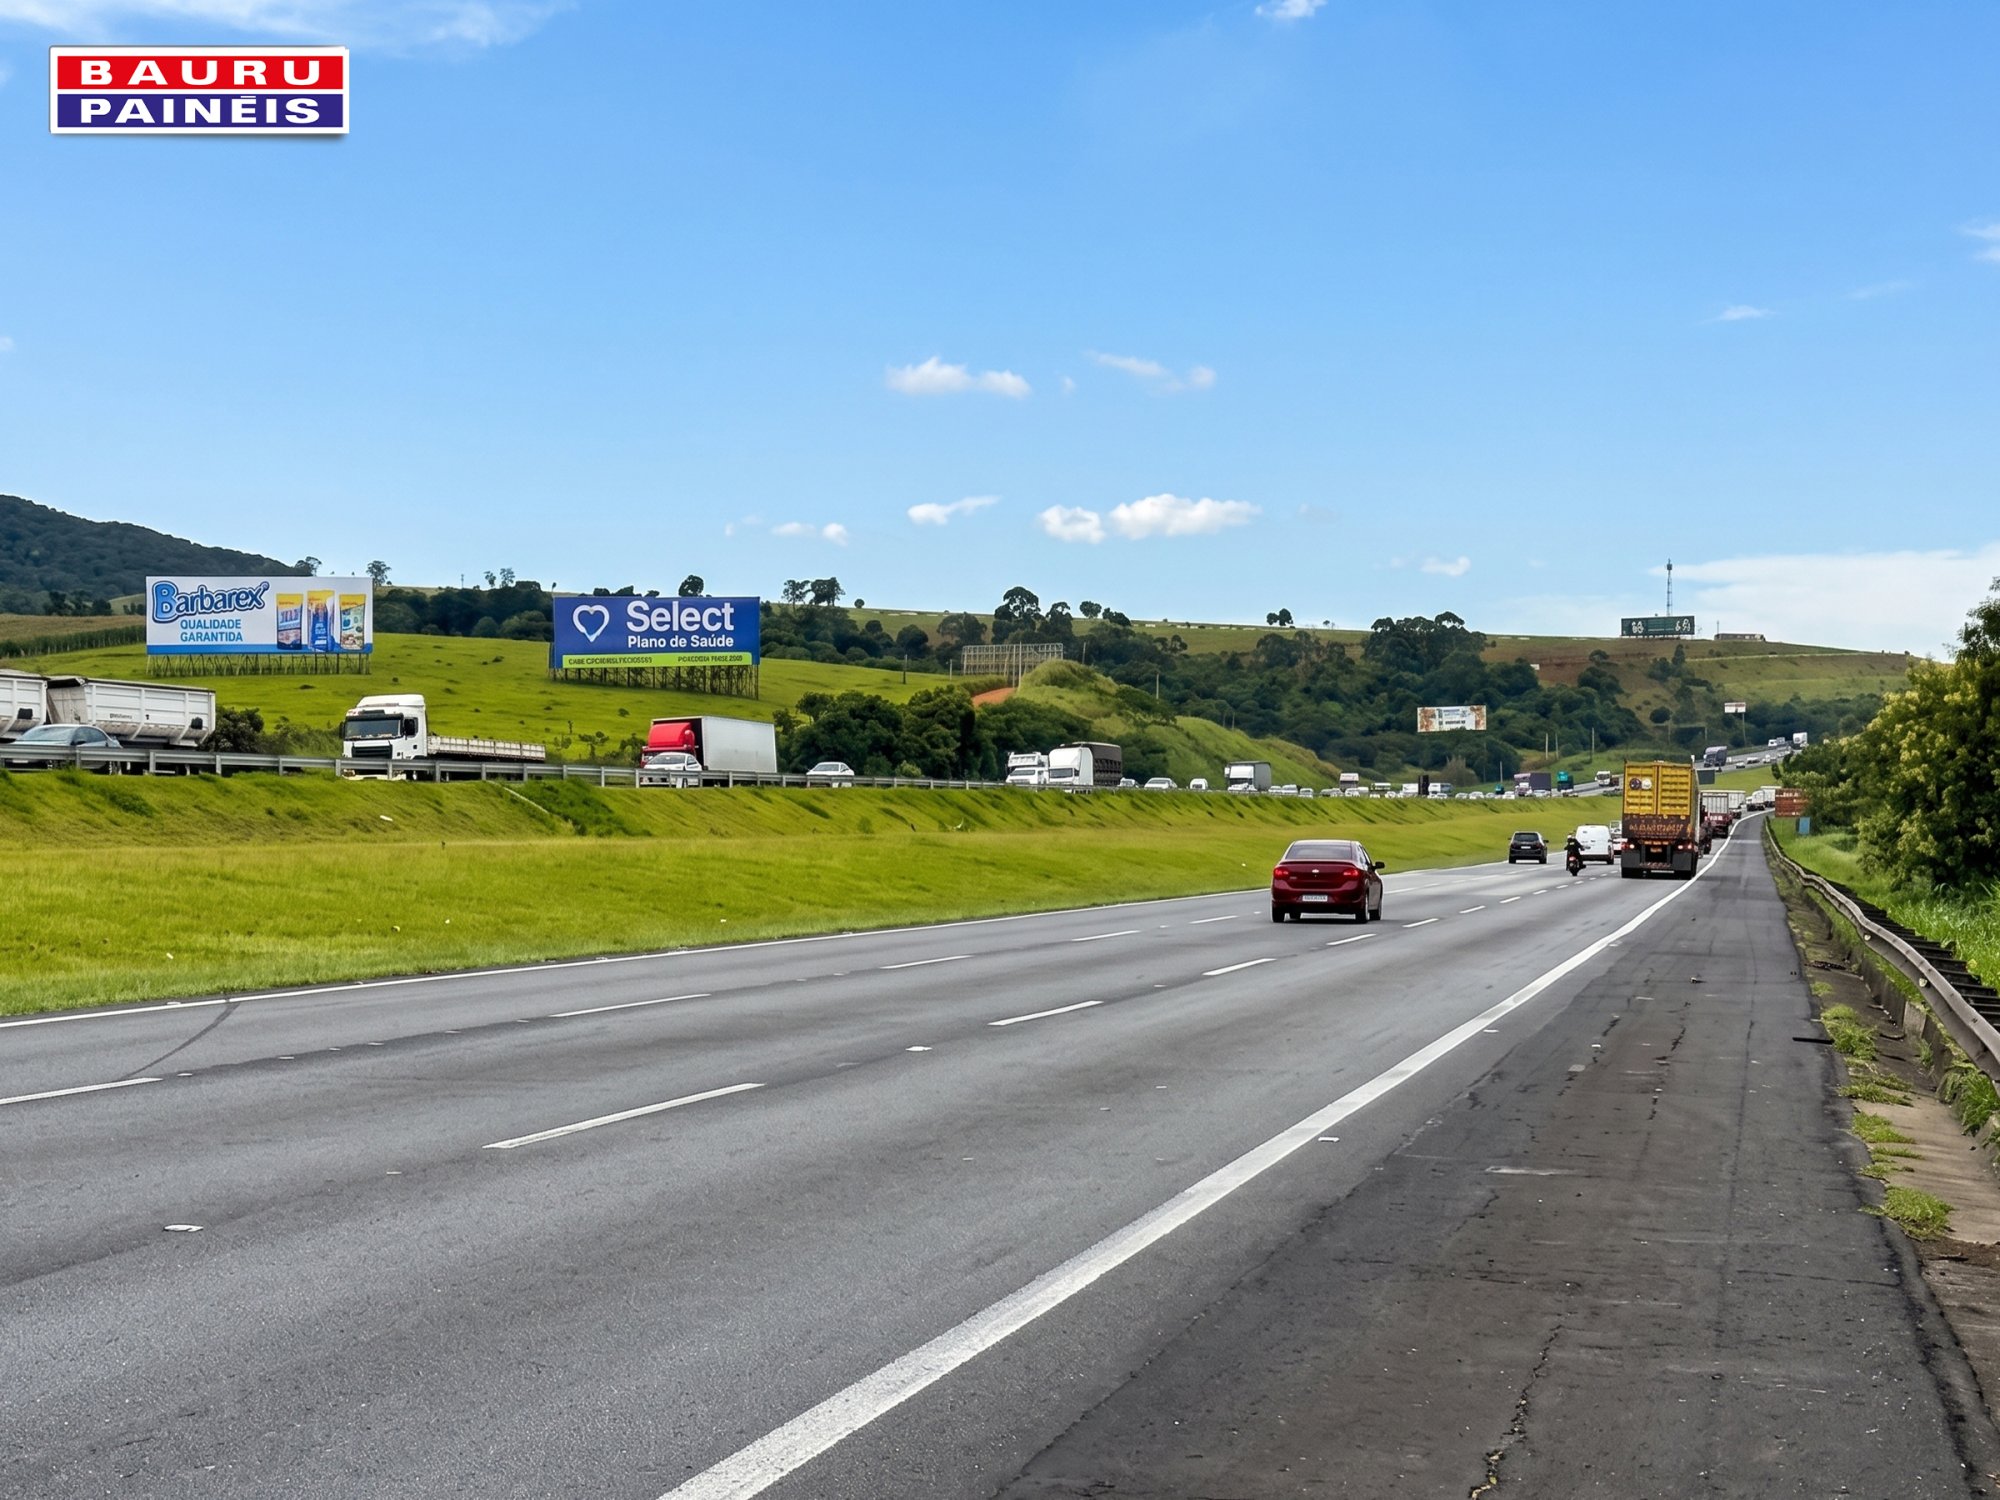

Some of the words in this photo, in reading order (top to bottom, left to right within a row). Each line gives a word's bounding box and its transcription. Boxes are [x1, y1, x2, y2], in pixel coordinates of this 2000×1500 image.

[152, 580, 270, 623] Barbarex
[626, 600, 735, 632] Select
[180, 619, 242, 630] QUALIDADE
[180, 631, 243, 642] GARANTIDA
[628, 636, 667, 648] Plano
[670, 636, 687, 648] de
[691, 634, 735, 647] Saúde
